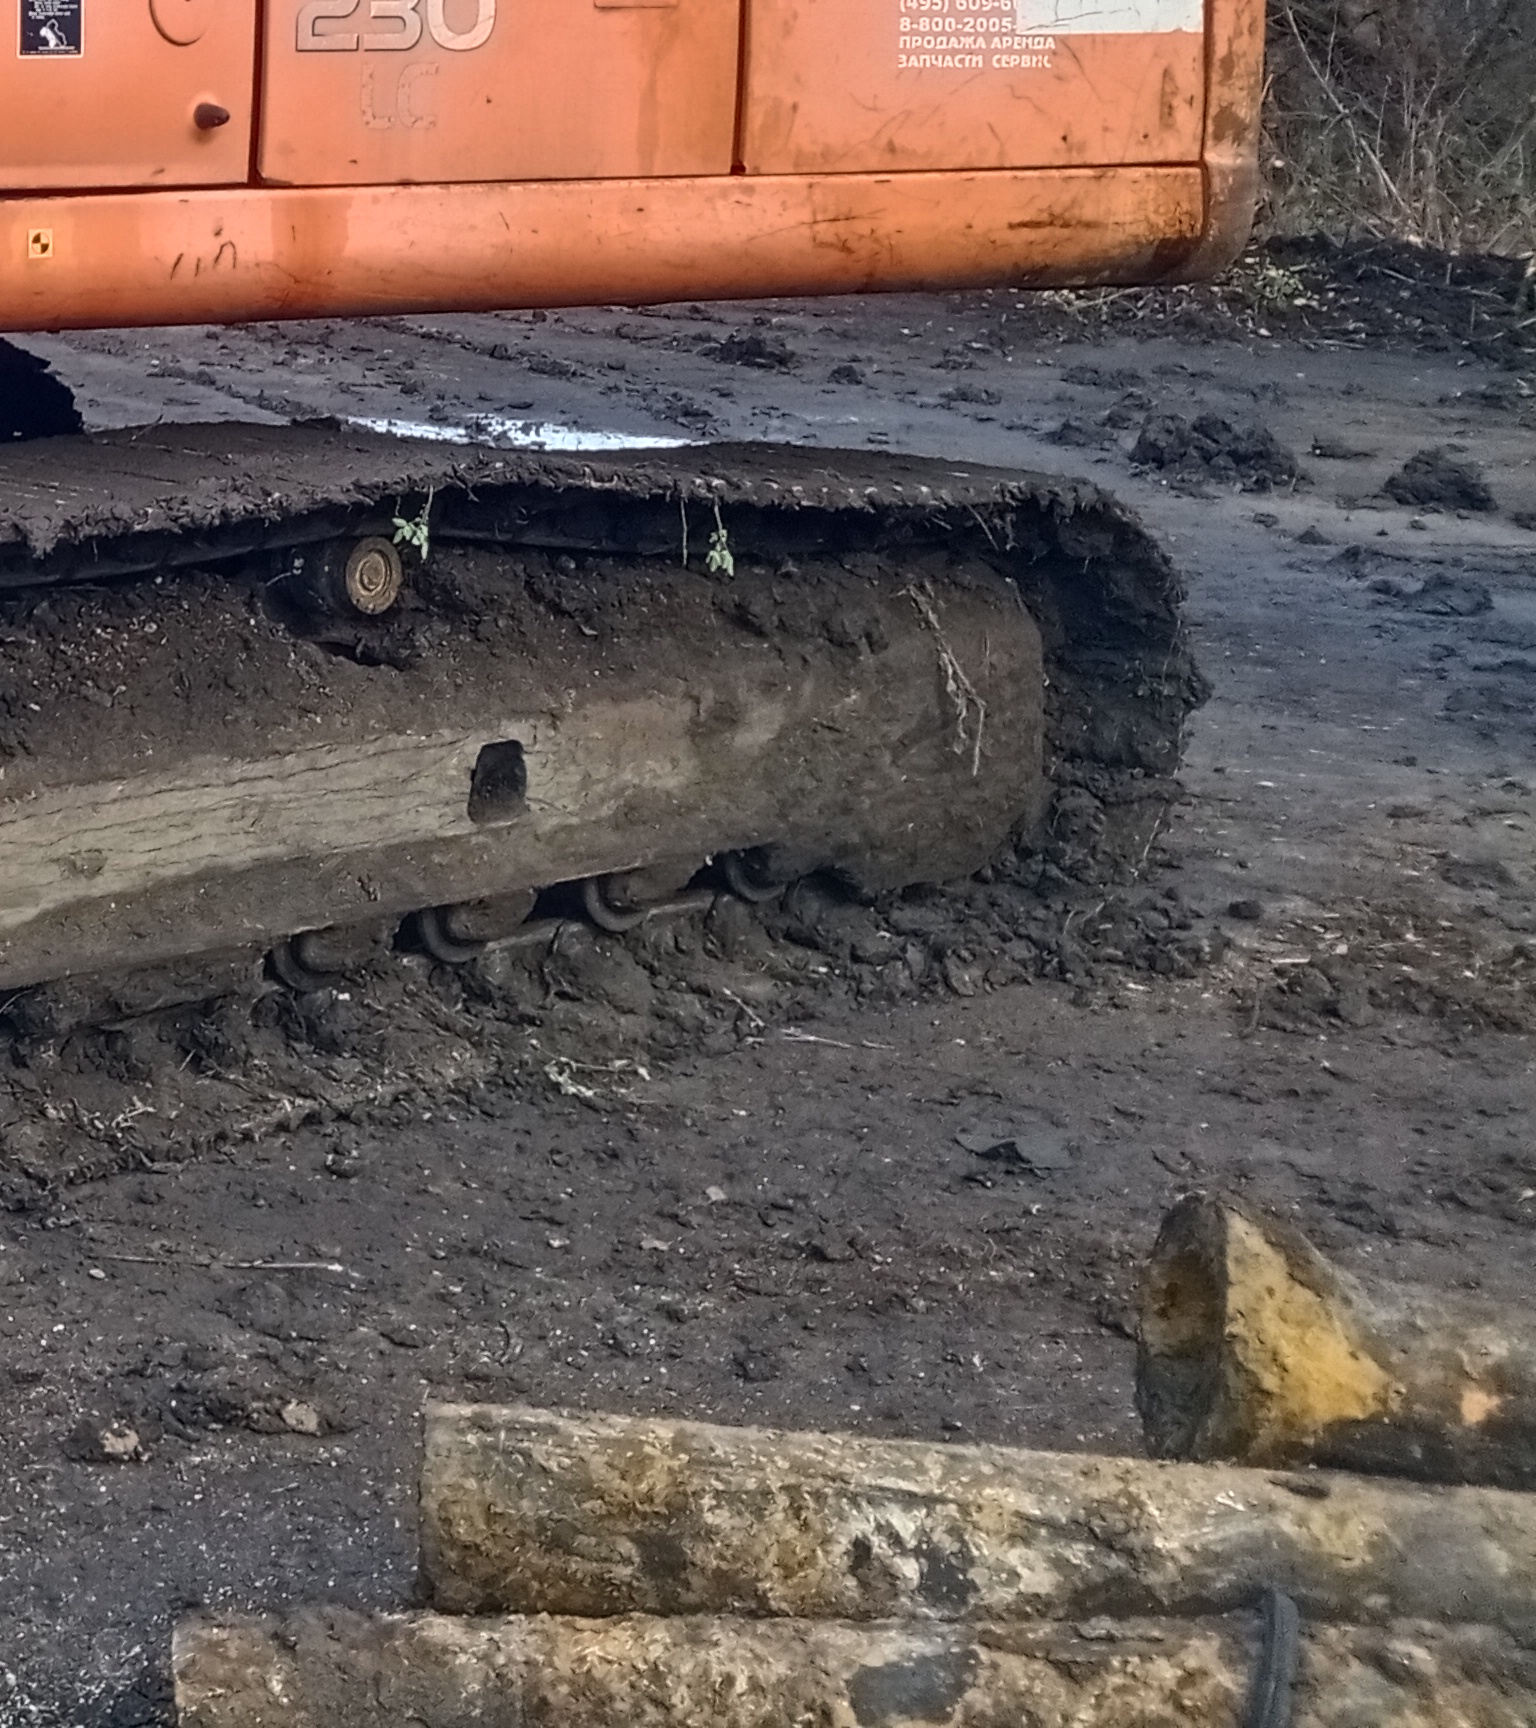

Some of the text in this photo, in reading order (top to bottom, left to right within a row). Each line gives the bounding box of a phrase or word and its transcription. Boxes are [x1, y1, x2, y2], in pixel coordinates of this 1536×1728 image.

[899, 16, 1017, 33] 8-800-2005-
[899, 36, 1056, 49] ПРОДАЖА АРЕНДА
[898, 54, 1052, 68] ЗАПЧАСТИ СЕРВИС
